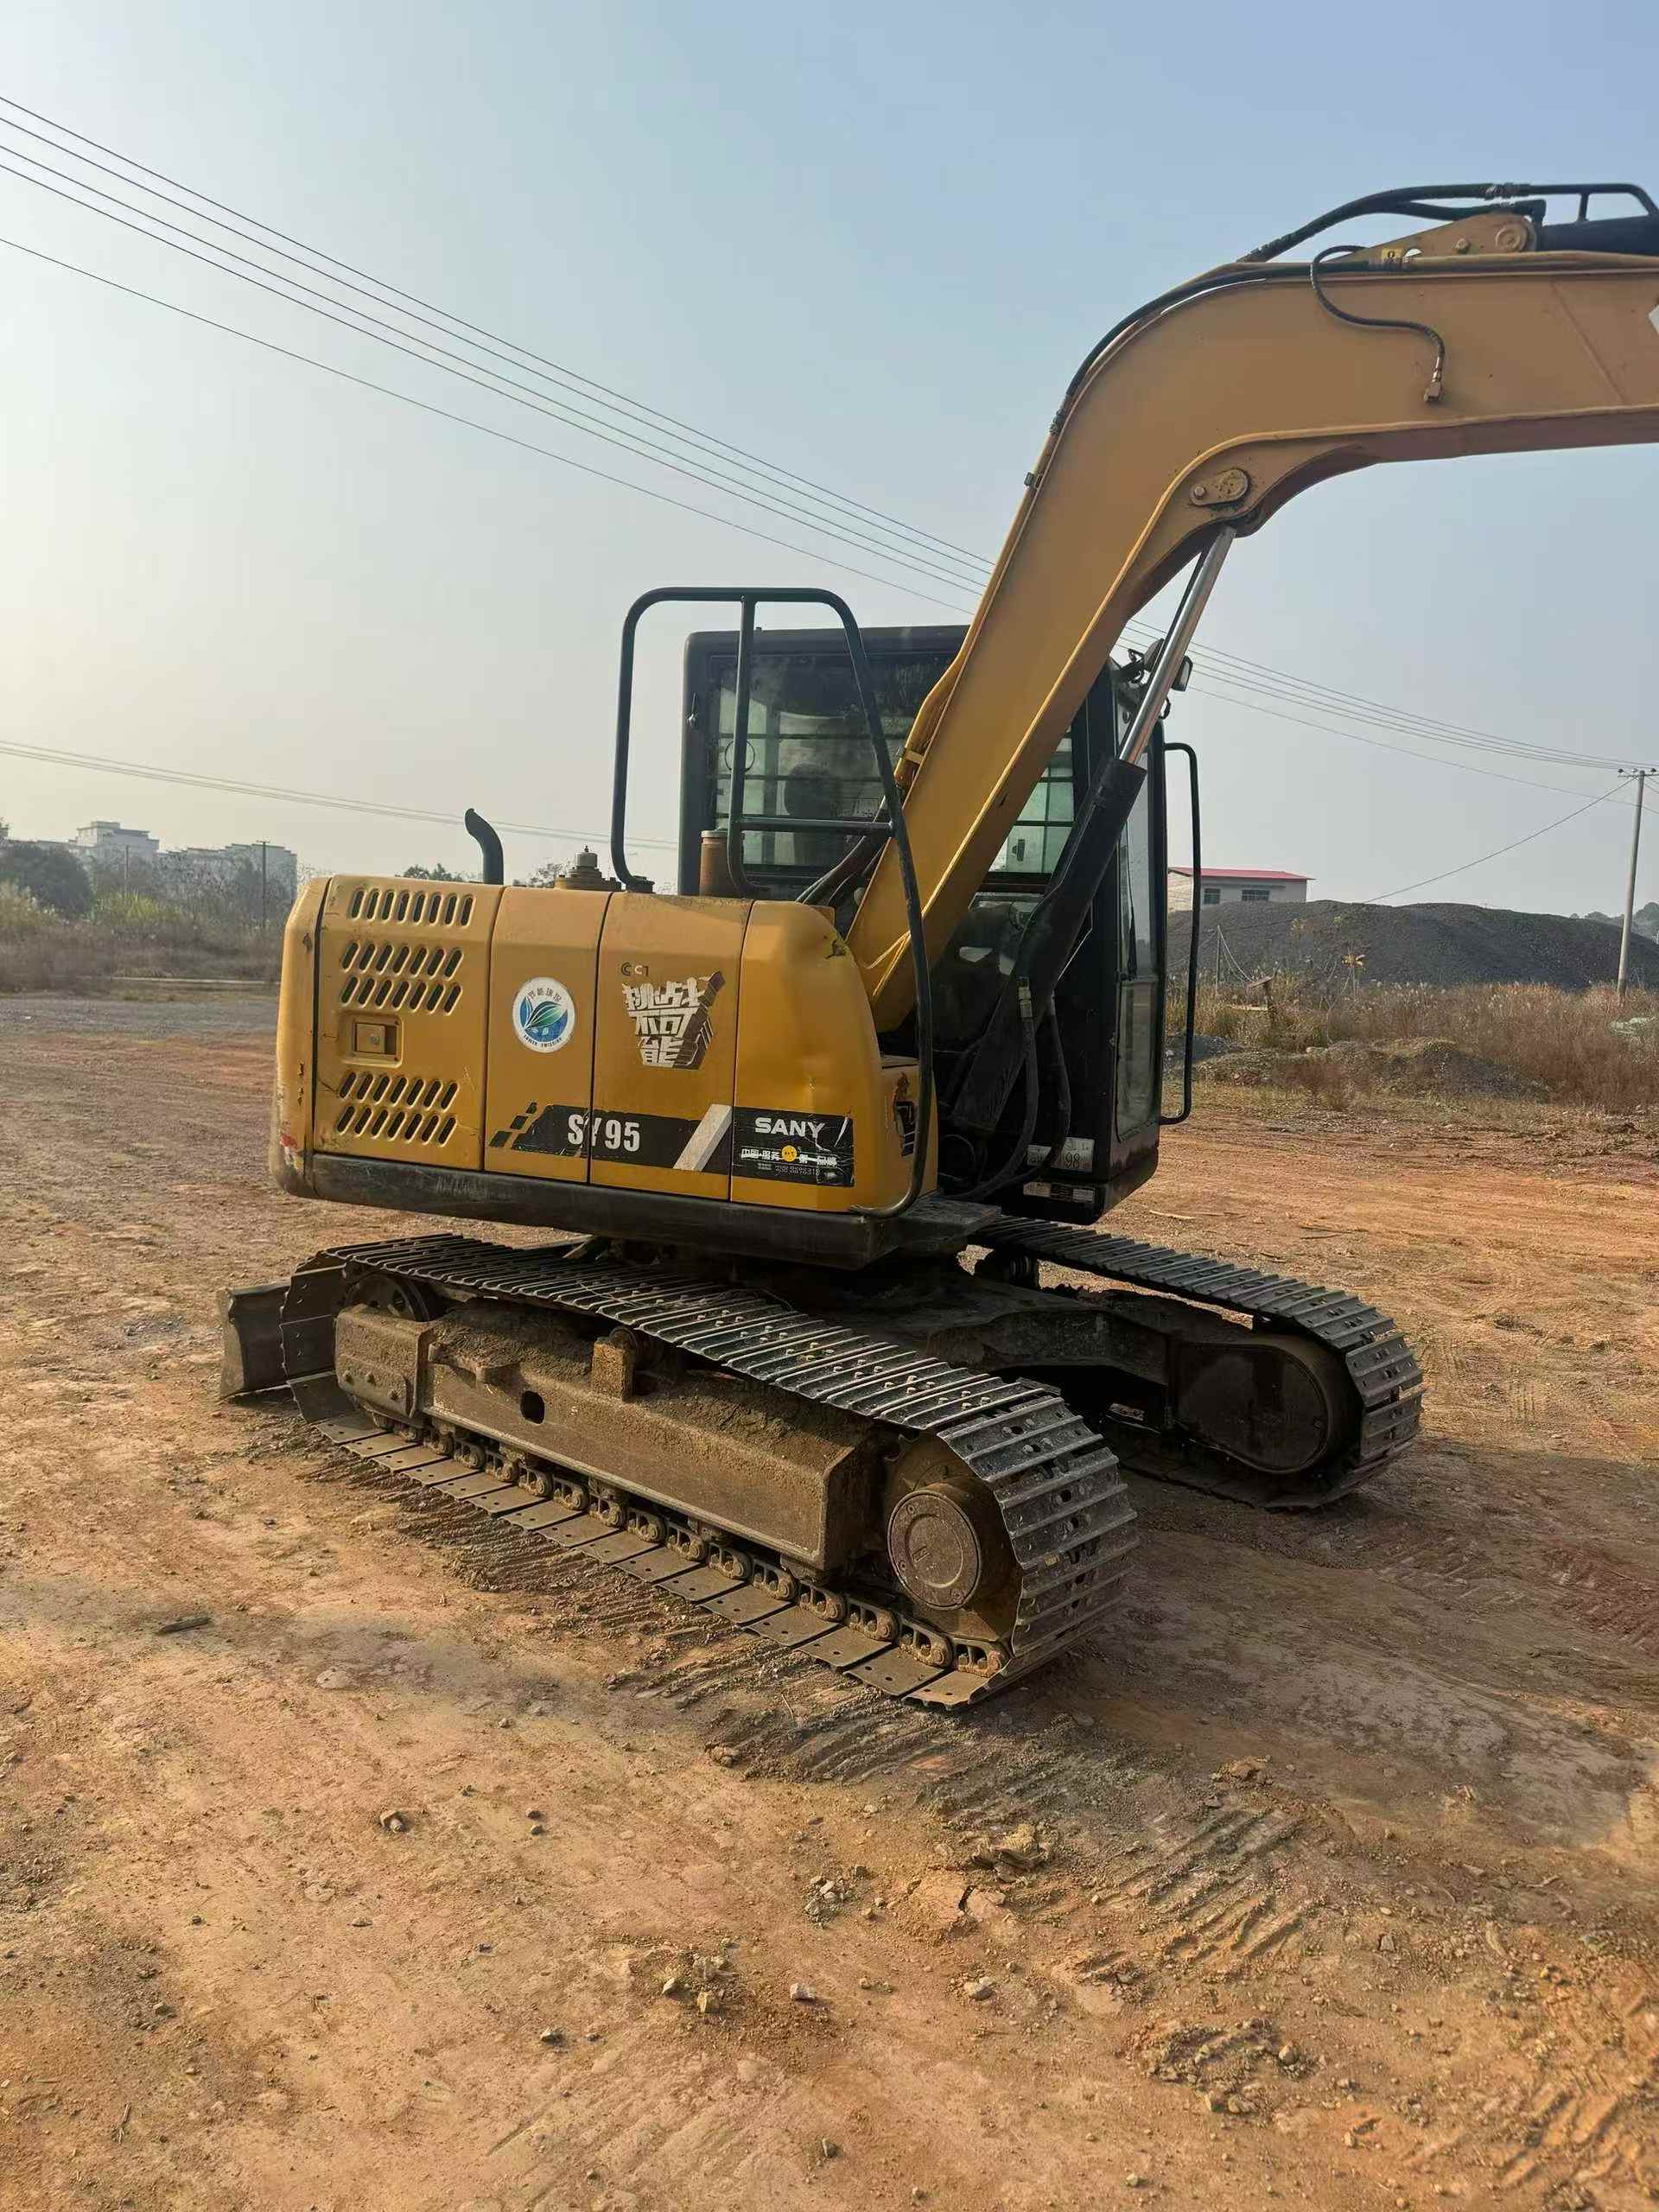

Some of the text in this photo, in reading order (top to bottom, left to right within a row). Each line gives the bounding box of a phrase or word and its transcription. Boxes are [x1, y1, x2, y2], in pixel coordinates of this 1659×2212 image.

[621, 976, 709, 1010] 挑战
[627, 1007, 699, 1039] 不可
[637, 1035, 684, 1068] 能
[754, 1116, 825, 1138] SANY
